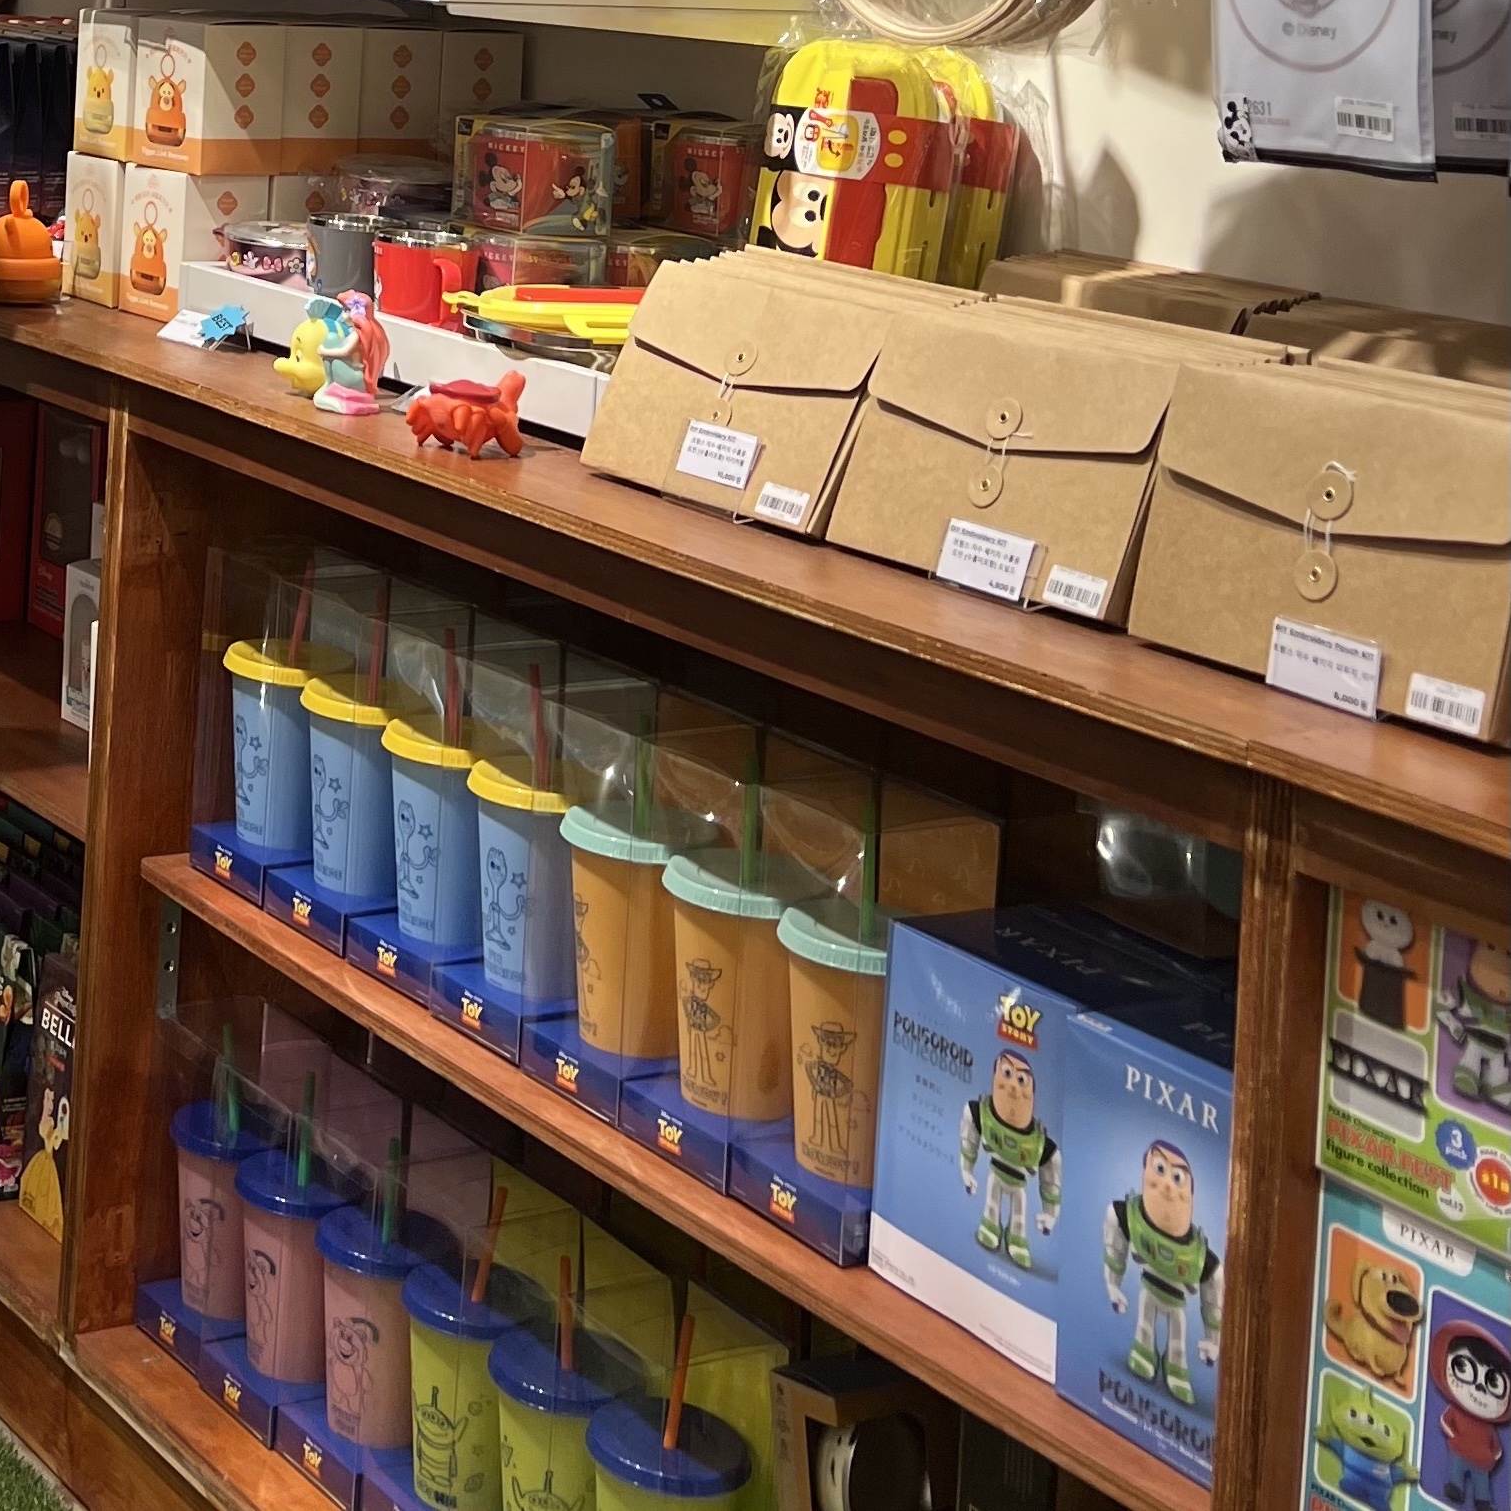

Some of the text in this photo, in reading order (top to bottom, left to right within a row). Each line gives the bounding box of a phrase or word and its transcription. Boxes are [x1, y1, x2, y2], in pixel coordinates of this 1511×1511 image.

[1297, 21, 1338, 40] Disney
[487, 140, 527, 154] MICKEY
[686, 147, 724, 158] MICKEY
[212, 313, 233, 331] BEST
[1289, 627, 1333, 649] Embroidery
[292, 896, 312, 918] TOY
[377, 946, 398, 968] TOY
[461, 997, 484, 1020] TOY
[999, 995, 1042, 1032] TOY
[1000, 1022, 1035, 1046] STORY
[555, 1057, 580, 1082] TOY
[1124, 1063, 1220, 1135] PIXAR
[657, 1118, 683, 1144] TOY
[1449, 1128, 1464, 1149] 3
[1325, 1114, 1398, 1166] PIXAR
[1398, 1150, 1456, 1195] FEST
[1444, 1146, 1468, 1161] pack
[1325, 1138, 1430, 1199] figure collection
[770, 1182, 797, 1211] TOY
[1399, 1222, 1456, 1263] PIXAR
